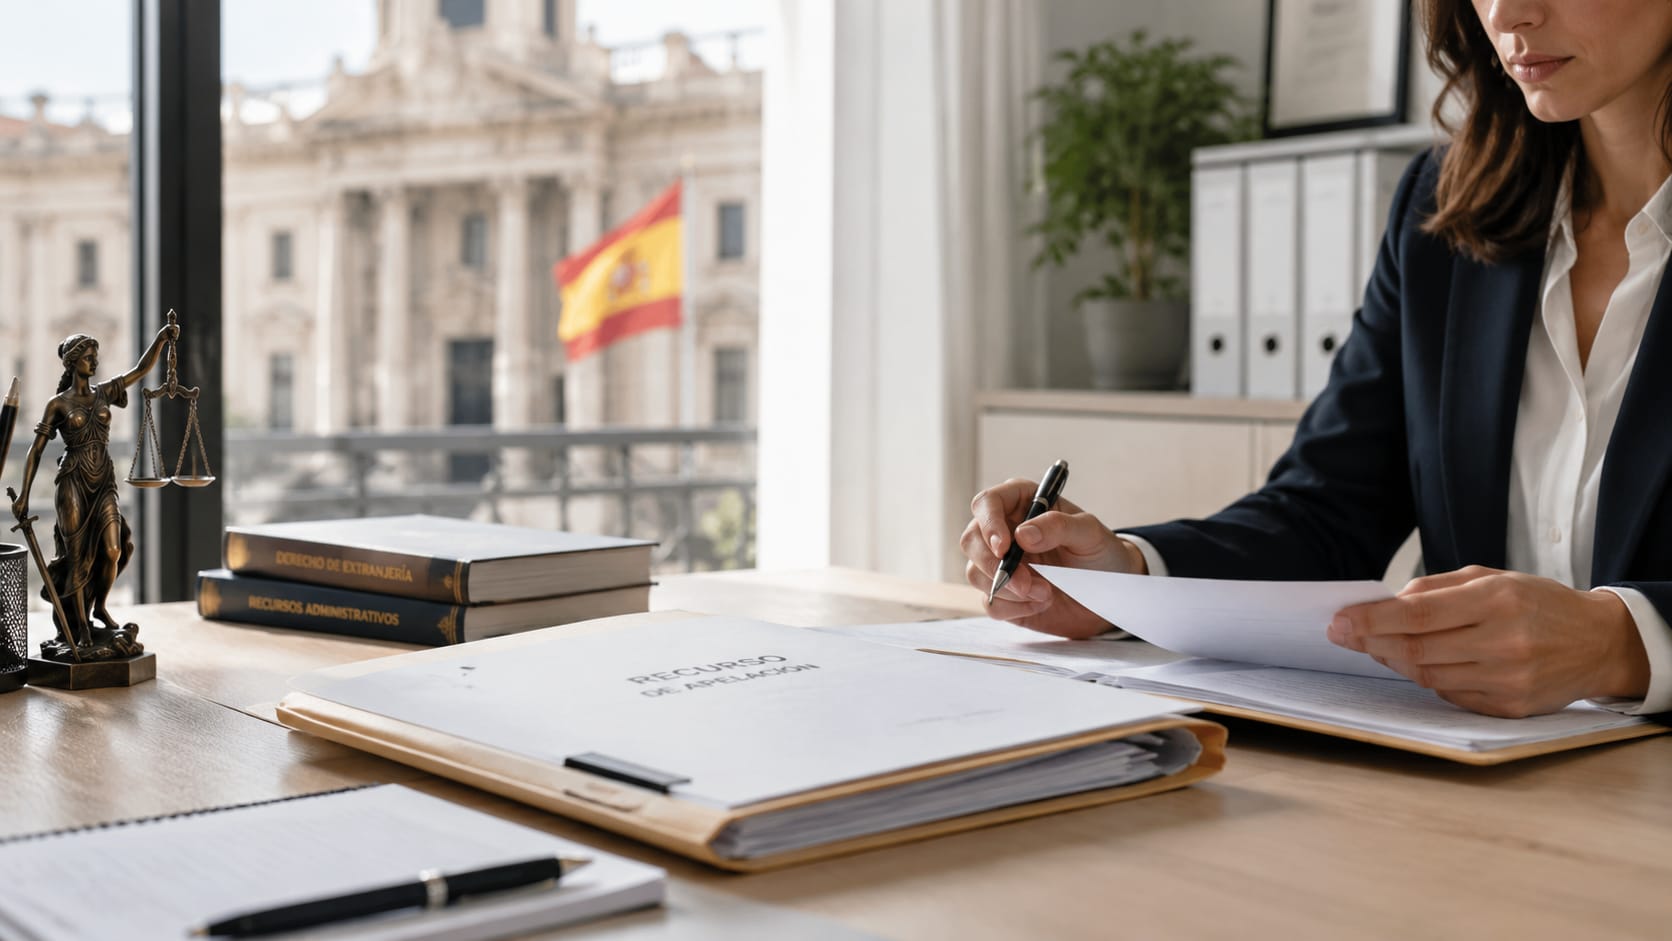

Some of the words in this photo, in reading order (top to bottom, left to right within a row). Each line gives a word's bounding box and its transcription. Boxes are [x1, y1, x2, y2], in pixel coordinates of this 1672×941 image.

[276, 551, 325, 570] DERECHO
[326, 557, 340, 573] DE
[343, 560, 413, 582] EXTRANJERÍA
[248, 595, 303, 615] RECURSOS
[305, 602, 400, 626] ADMINISTRATIVOS
[627, 655, 787, 684] RECURSO
[640, 686, 681, 697] DE
